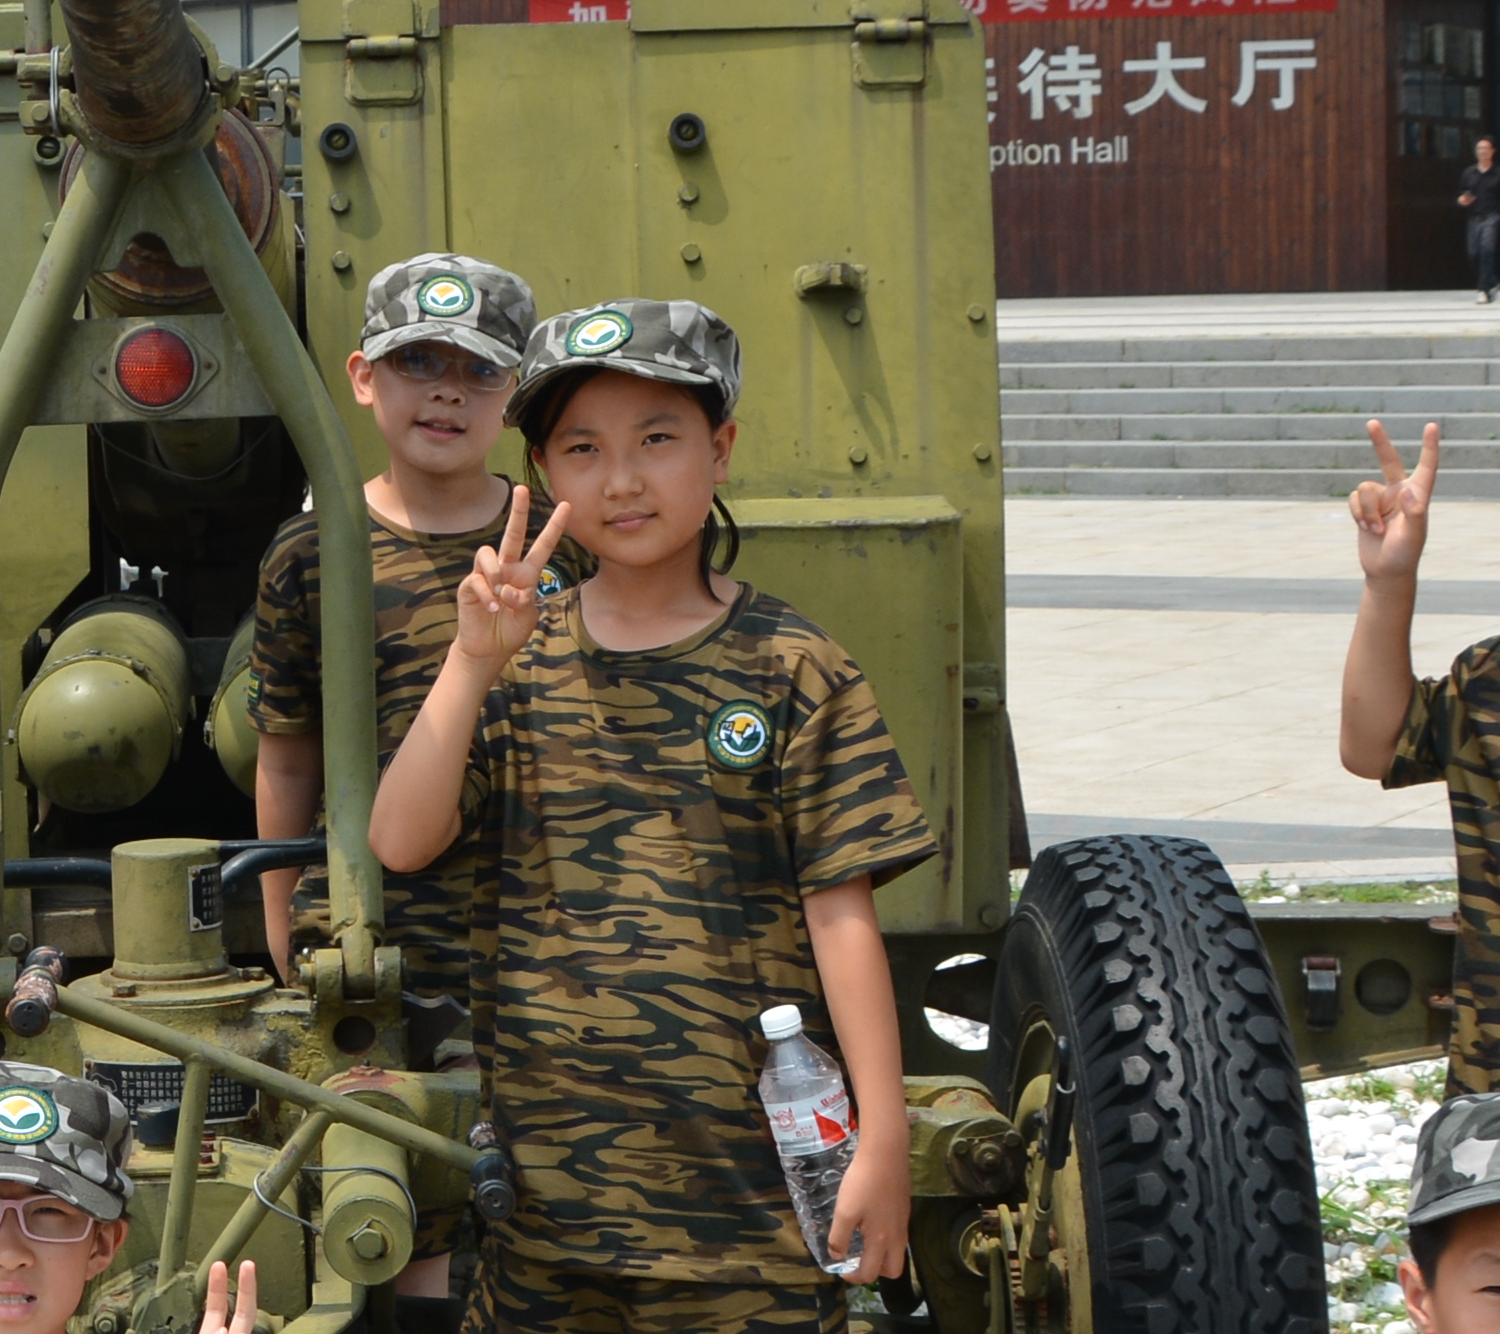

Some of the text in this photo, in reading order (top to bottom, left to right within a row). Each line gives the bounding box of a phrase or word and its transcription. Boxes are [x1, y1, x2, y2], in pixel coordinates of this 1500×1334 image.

[985, 38, 1318, 123] 待大厅
[1071, 134, 1129, 165] Hall
